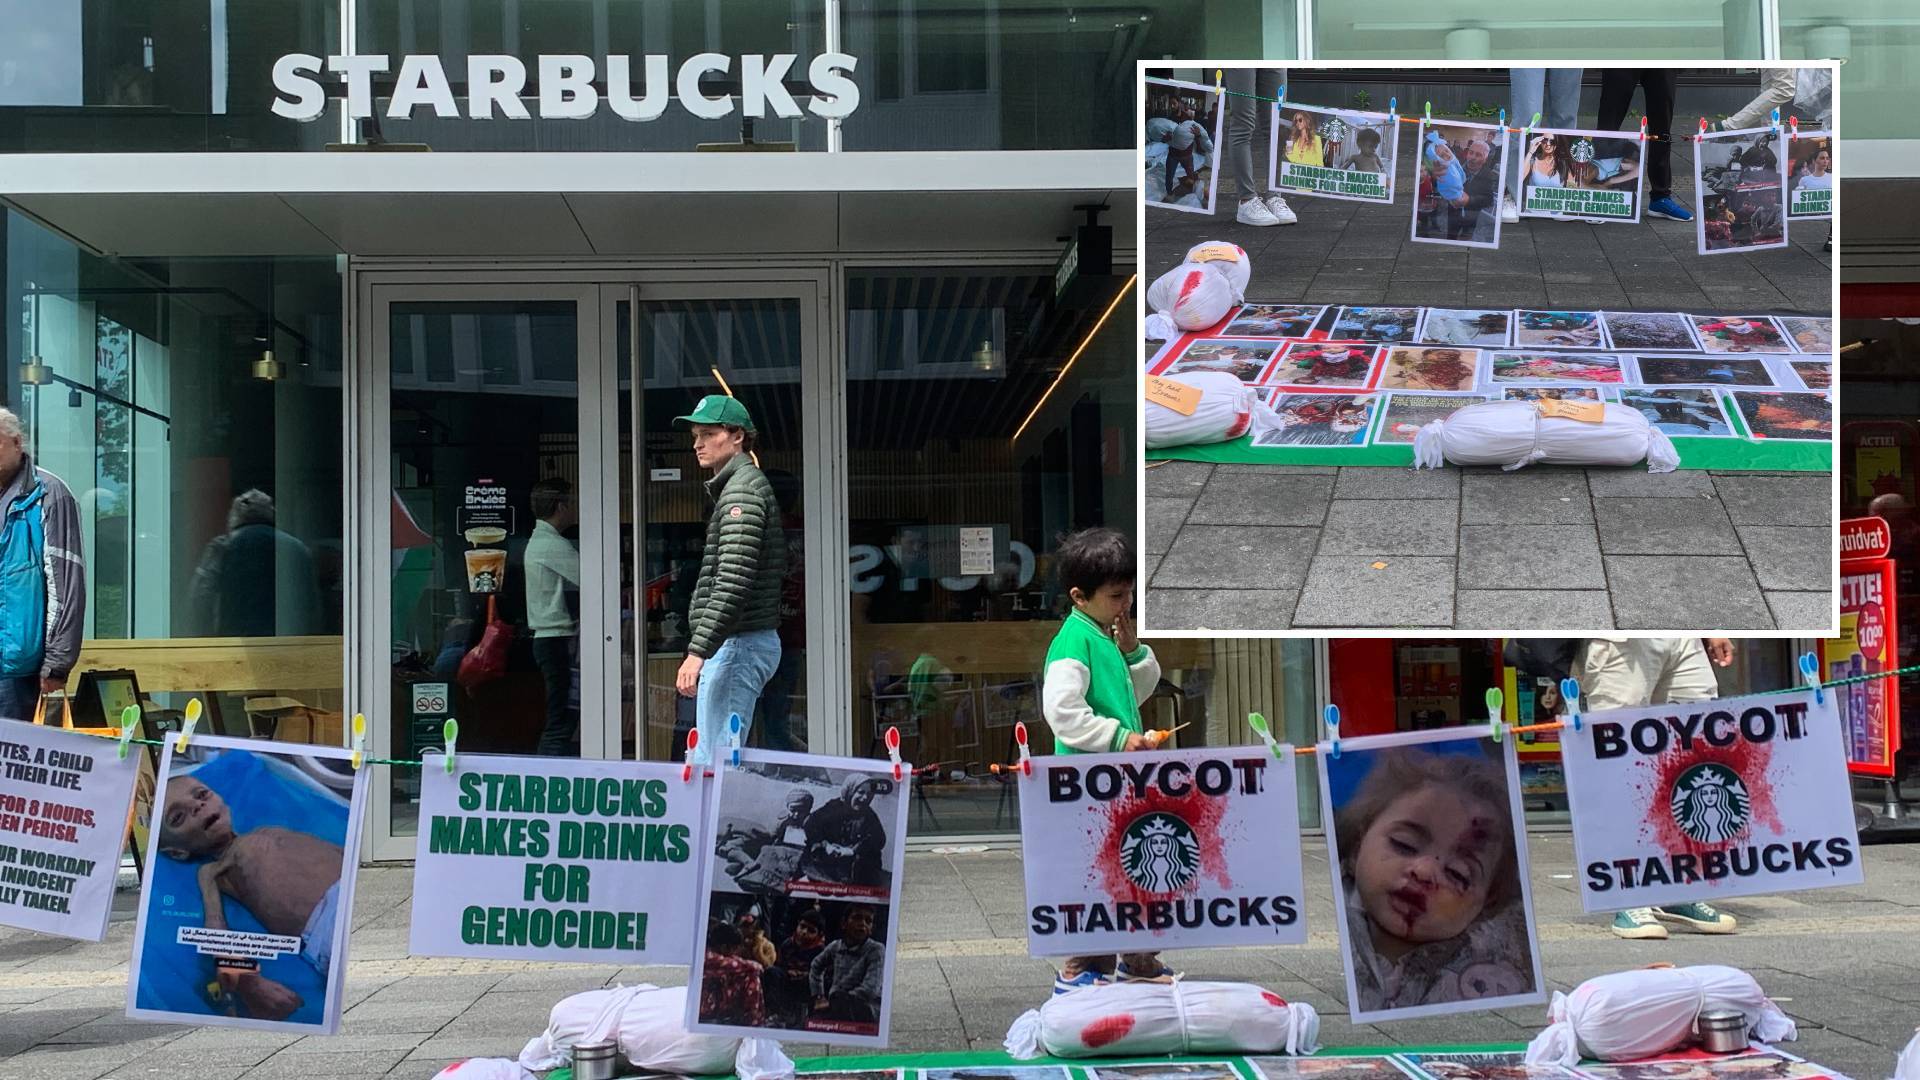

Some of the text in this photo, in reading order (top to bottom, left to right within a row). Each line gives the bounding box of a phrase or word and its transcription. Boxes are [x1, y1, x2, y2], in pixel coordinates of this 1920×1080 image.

[271, 52, 860, 122] STARBUCKS
[1282, 175, 1386, 196] DRINKS FOR GENOCIDE
[1289, 164, 1379, 185] STARBUCKS MAKES
[1527, 198, 1631, 215] DRINKS FOR GENOCIDE
[1535, 187, 1625, 203] STARBUCKS MAKES
[1793, 201, 1829, 213] DRINKS
[1800, 190, 1832, 202] STARB
[1591, 701, 1809, 760] BOYCOT
[0, 741, 94, 773] TES, A CHILD
[6, 762, 82, 791] THEIR LIFE.
[1048, 758, 1267, 803] BOYCOT
[459, 772, 667, 818] STARBUCKS
[0, 794, 96, 828] FOR 8 HOURS,
[0, 813, 78, 843] EN PERISH.
[429, 816, 690, 863] MAKES DRINKS
[20, 848, 96, 877] WORKDAY
[1586, 837, 1854, 892] STARBUCKS
[1, 866, 77, 894] INNOCENT
[524, 863, 590, 903] FOR
[23, 890, 71, 914] TAKEN.
[1031, 895, 1298, 935] STARBUCKS
[461, 905, 648, 951] GENOCIDE!
[262, 945, 295, 953] constantly
